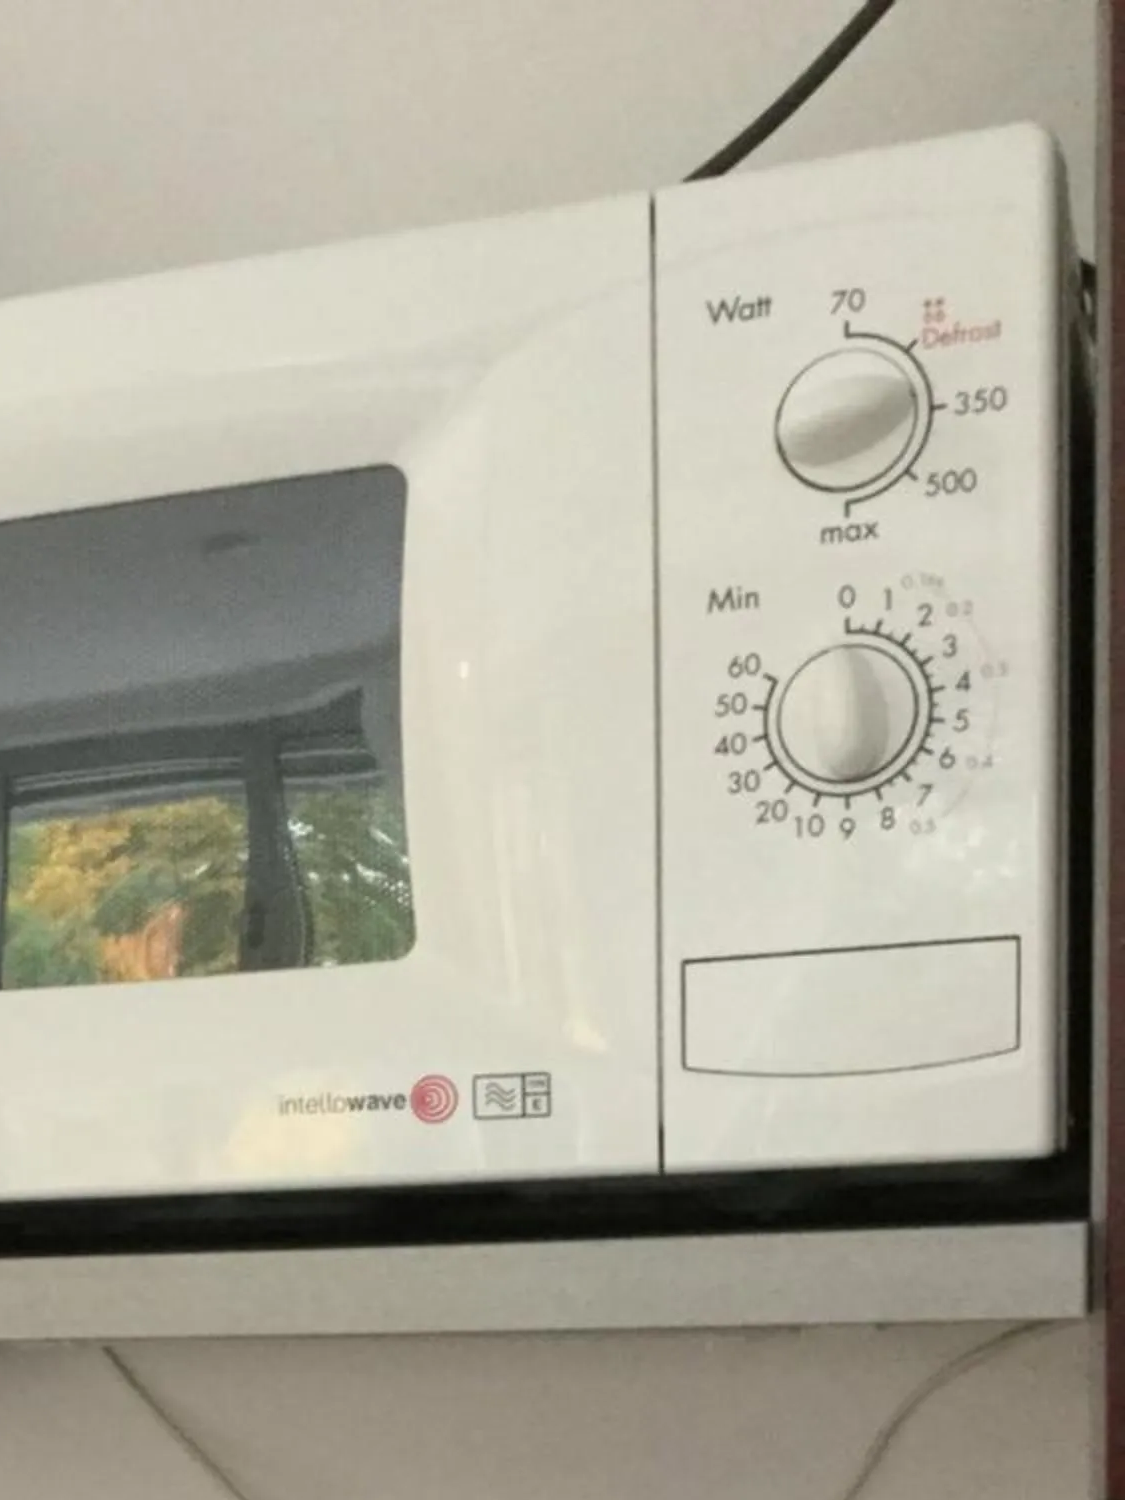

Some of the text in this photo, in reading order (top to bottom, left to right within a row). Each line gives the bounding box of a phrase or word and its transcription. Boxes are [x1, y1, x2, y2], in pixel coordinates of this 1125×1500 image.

[706, 295, 773, 325] Watt
[830, 287, 866, 315] 70
[921, 319, 1002, 350] Defrost
[954, 386, 1008, 416] 350
[924, 468, 978, 498] 500
[820, 521, 880, 546] max
[707, 586, 761, 614] Min
[837, 584, 857, 610] 0
[884, 587, 893, 611] 1
[917, 603, 933, 628] 2
[942, 634, 958, 660] 3
[727, 652, 762, 679] 60
[955, 670, 972, 692] 4
[714, 691, 748, 718] 50
[952, 708, 970, 733] 5
[714, 732, 748, 756] 40
[938, 746, 956, 770] 6
[727, 769, 761, 795] 30
[917, 783, 934, 807] 7
[755, 798, 789, 825] 20
[880, 806, 897, 832] 8
[795, 813, 826, 839] 10
[839, 817, 856, 840] 9
